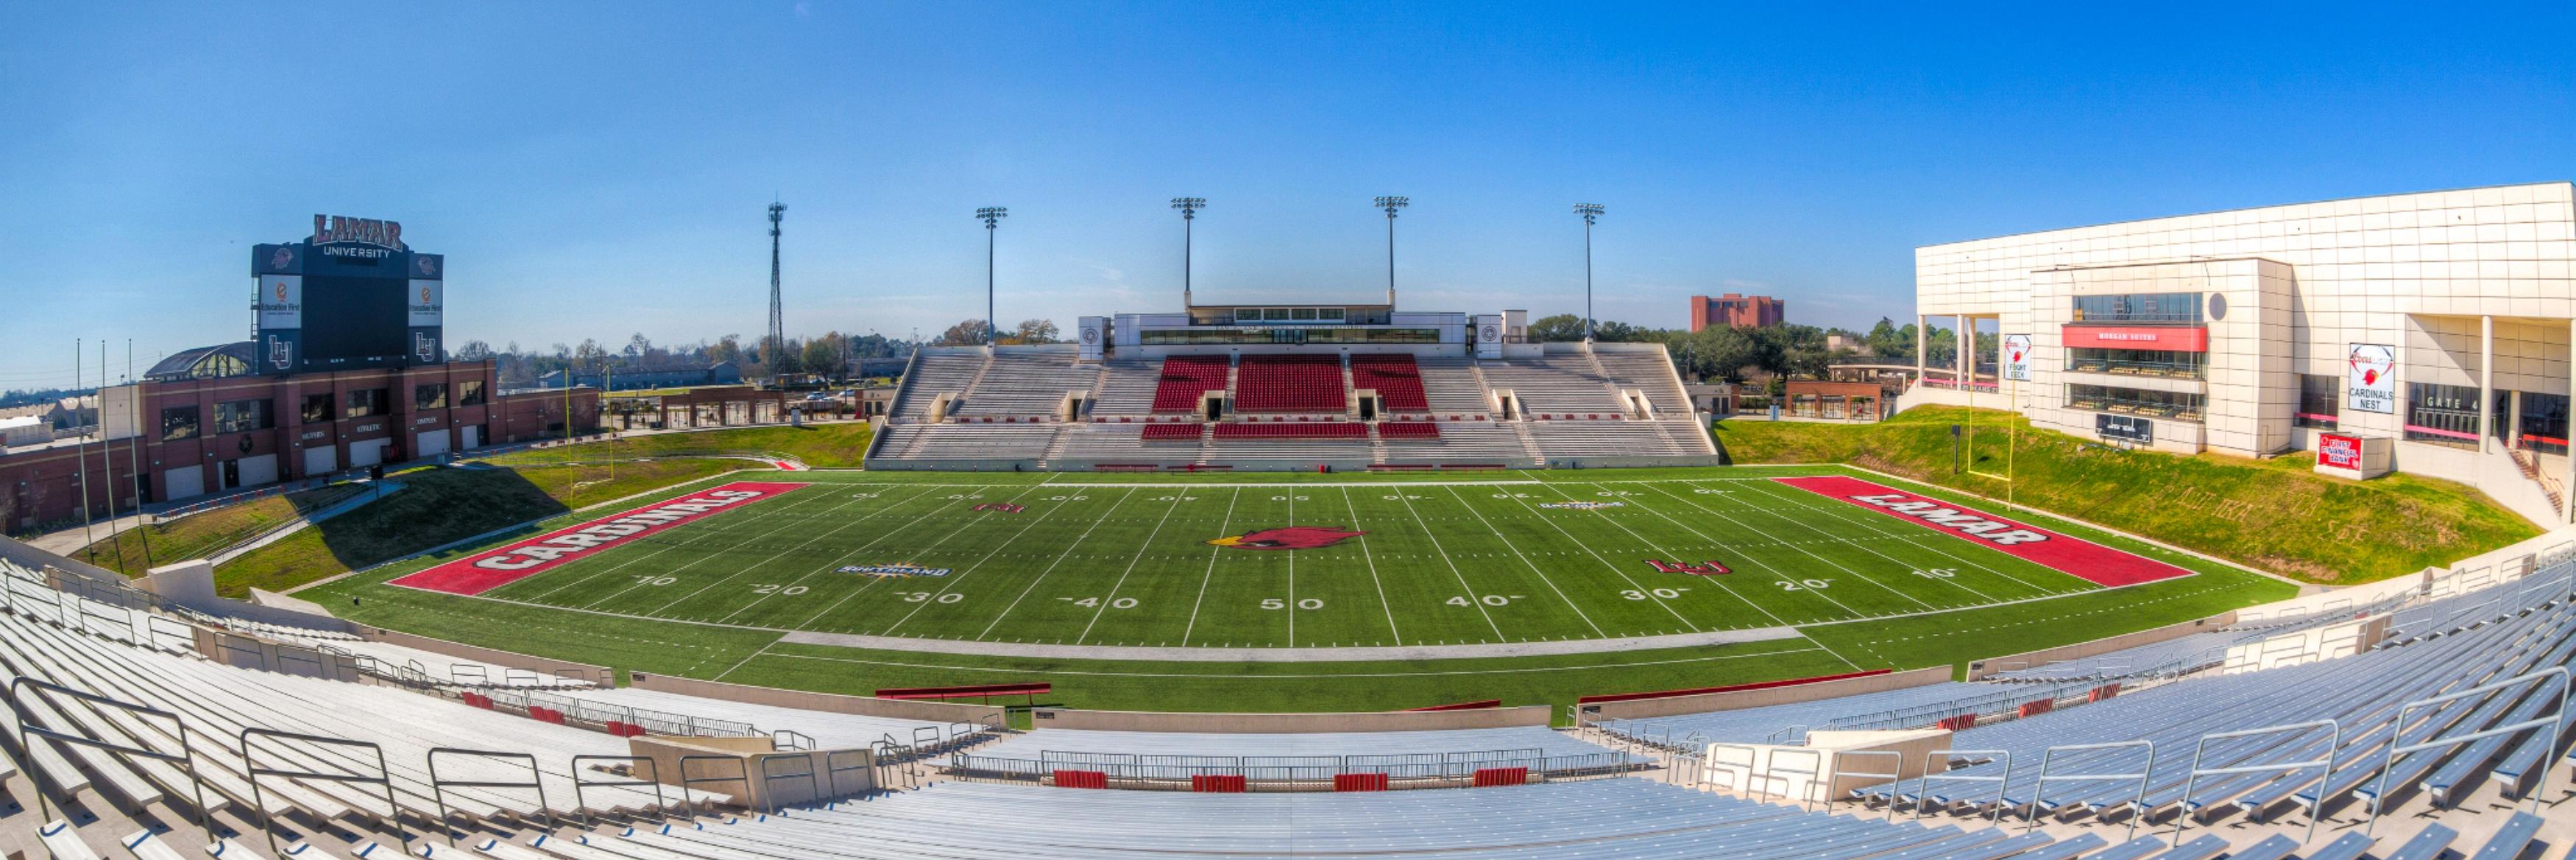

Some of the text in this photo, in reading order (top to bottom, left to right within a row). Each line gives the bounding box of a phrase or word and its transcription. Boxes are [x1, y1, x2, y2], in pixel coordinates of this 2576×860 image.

[313, 213, 403, 253] LAMAR
[324, 247, 390, 258] UNIVERSITY
[269, 334, 292, 369] LU
[416, 332, 436, 362] LU
[2350, 387, 2393, 401] CARDINALS
[2360, 399, 2381, 409] NEST
[2427, 397, 2479, 410] GATE 4
[2329, 440, 2351, 448] FIRST
[2321, 445, 2359, 459] FINANCIAL
[2329, 455, 2349, 465] BANK
[1847, 494, 2050, 545] LAMAR
[472, 490, 765, 571] CARDINALS
[836, 565, 949, 576] SOUTHLAND
[1912, 568, 1956, 579] 10
[636, 576, 677, 586] 10
[1774, 578, 1830, 591] 20
[752, 584, 810, 595] 20
[1620, 588, 1680, 601] 30
[904, 592, 963, 604] 30
[1074, 597, 1139, 609] 40
[1446, 595, 1510, 607] 40
[1260, 599, 1324, 610] 50
